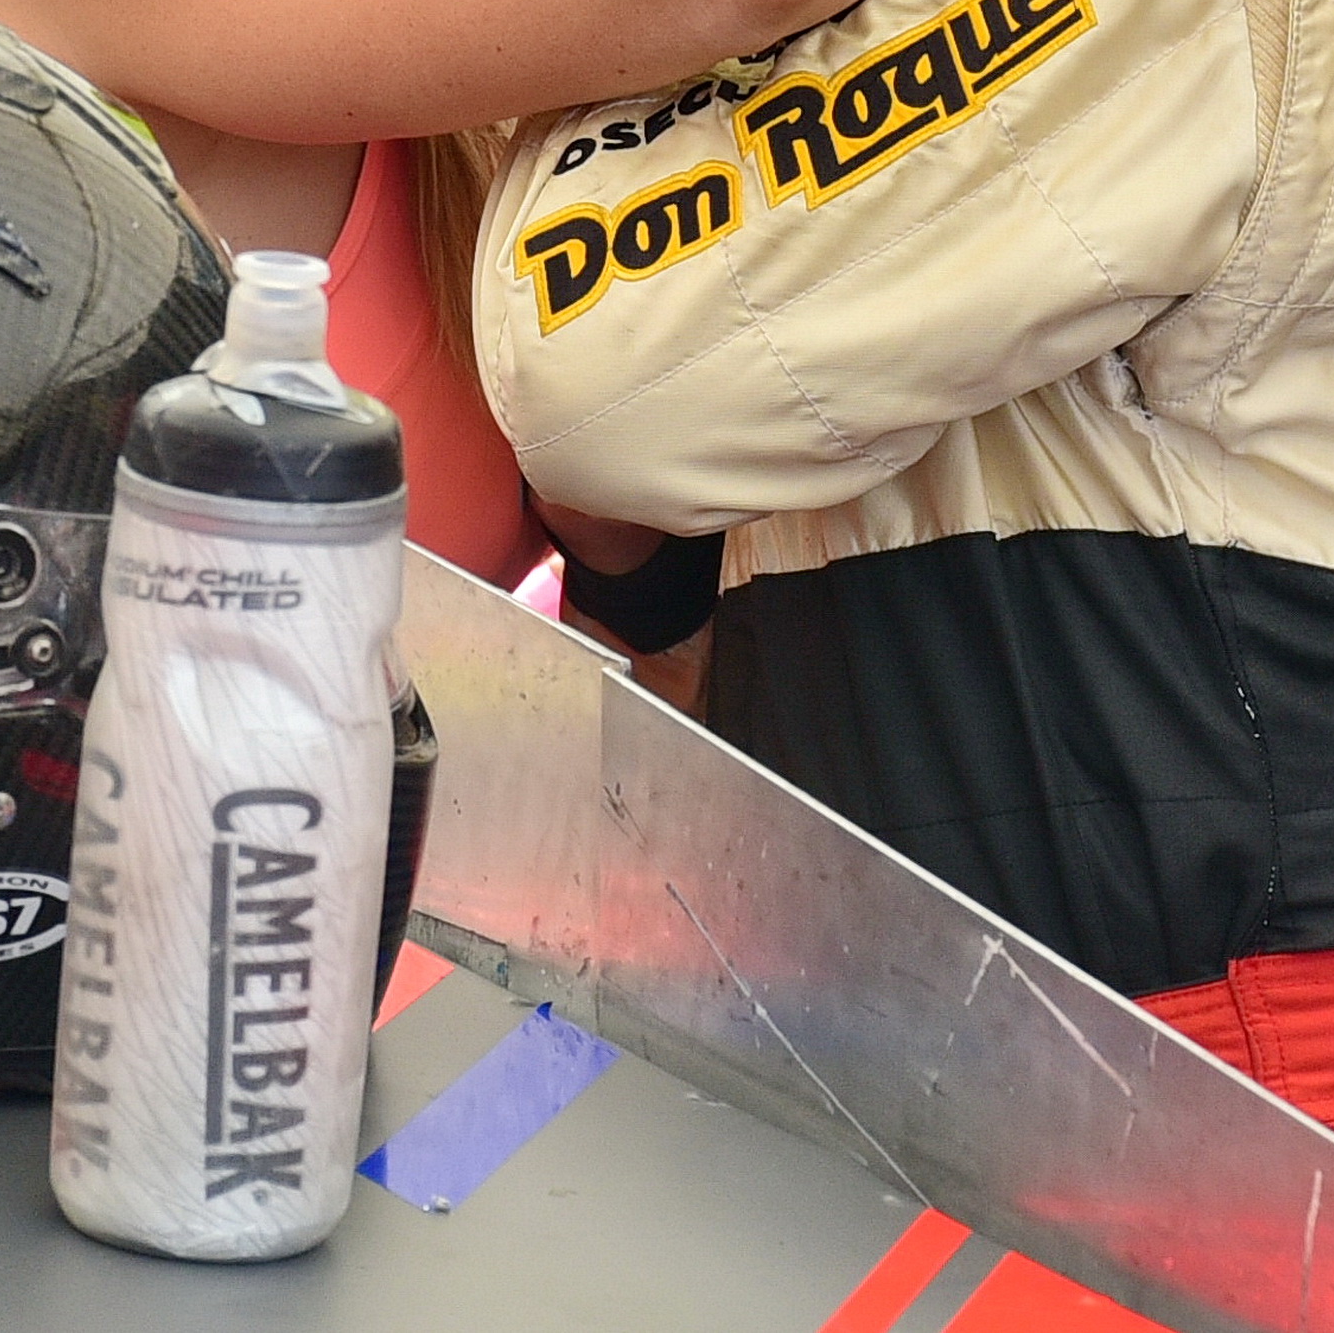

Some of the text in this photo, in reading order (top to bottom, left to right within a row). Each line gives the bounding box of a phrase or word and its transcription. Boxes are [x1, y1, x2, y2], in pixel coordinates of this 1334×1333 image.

[523, 172, 731, 316] Don
[197, 568, 302, 587] CHILL
[205, 788, 323, 1202] CAMELBAK
